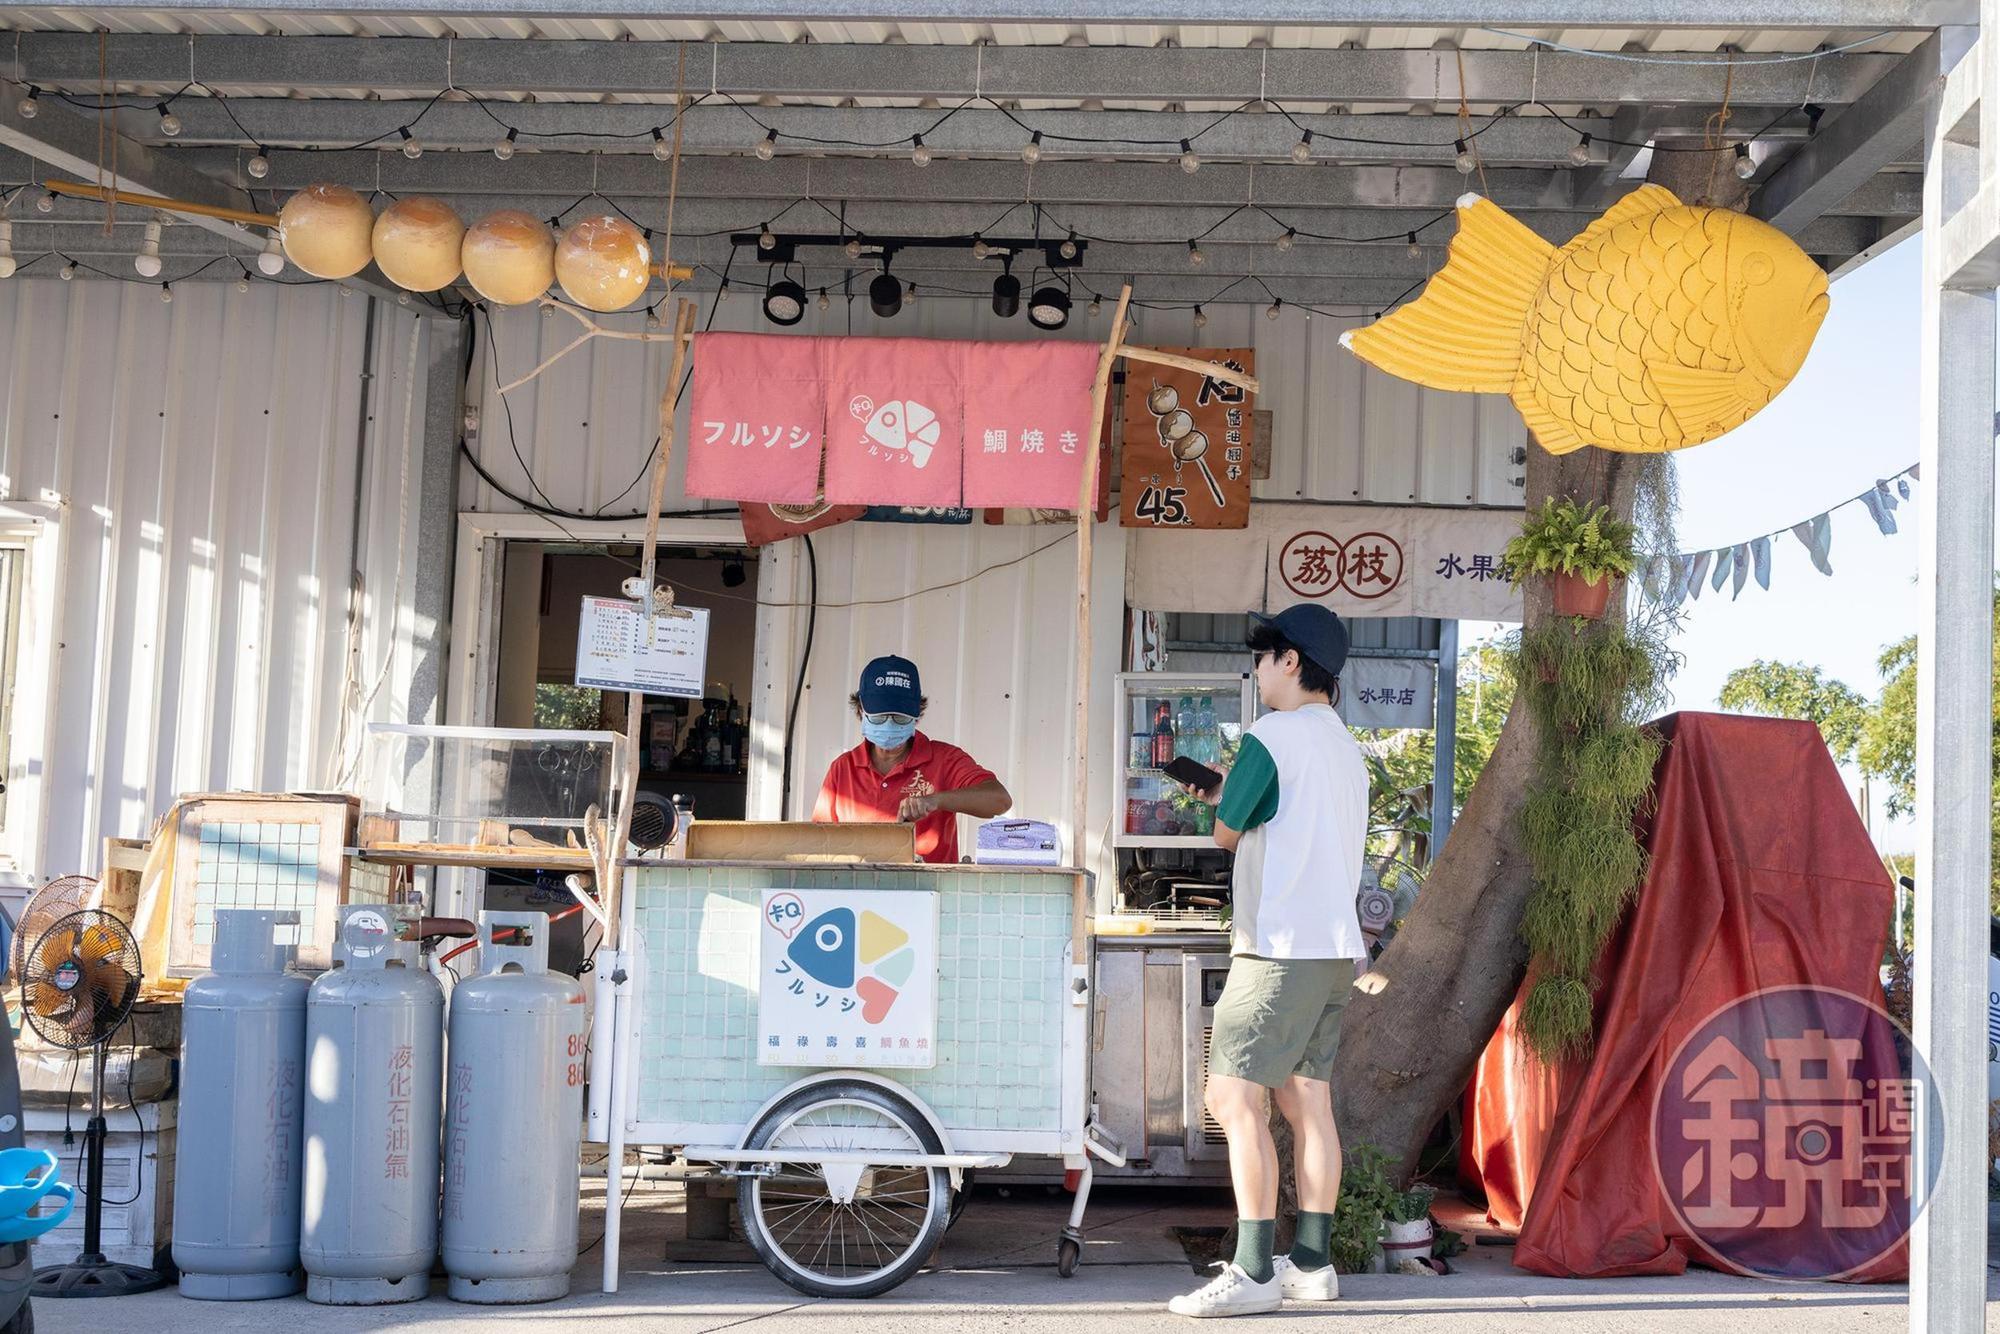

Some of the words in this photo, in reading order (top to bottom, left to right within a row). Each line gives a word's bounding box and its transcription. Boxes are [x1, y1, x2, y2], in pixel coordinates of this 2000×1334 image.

[703, 421, 811, 449] フルソシ
[983, 428, 1079, 454] 鯛焼き
[1292, 545, 1392, 586] 荔枝
[1359, 688, 1416, 705] 水果店
[775, 959, 856, 1012] フルソシ
[384, 1044, 412, 1179] 液化石油氣
